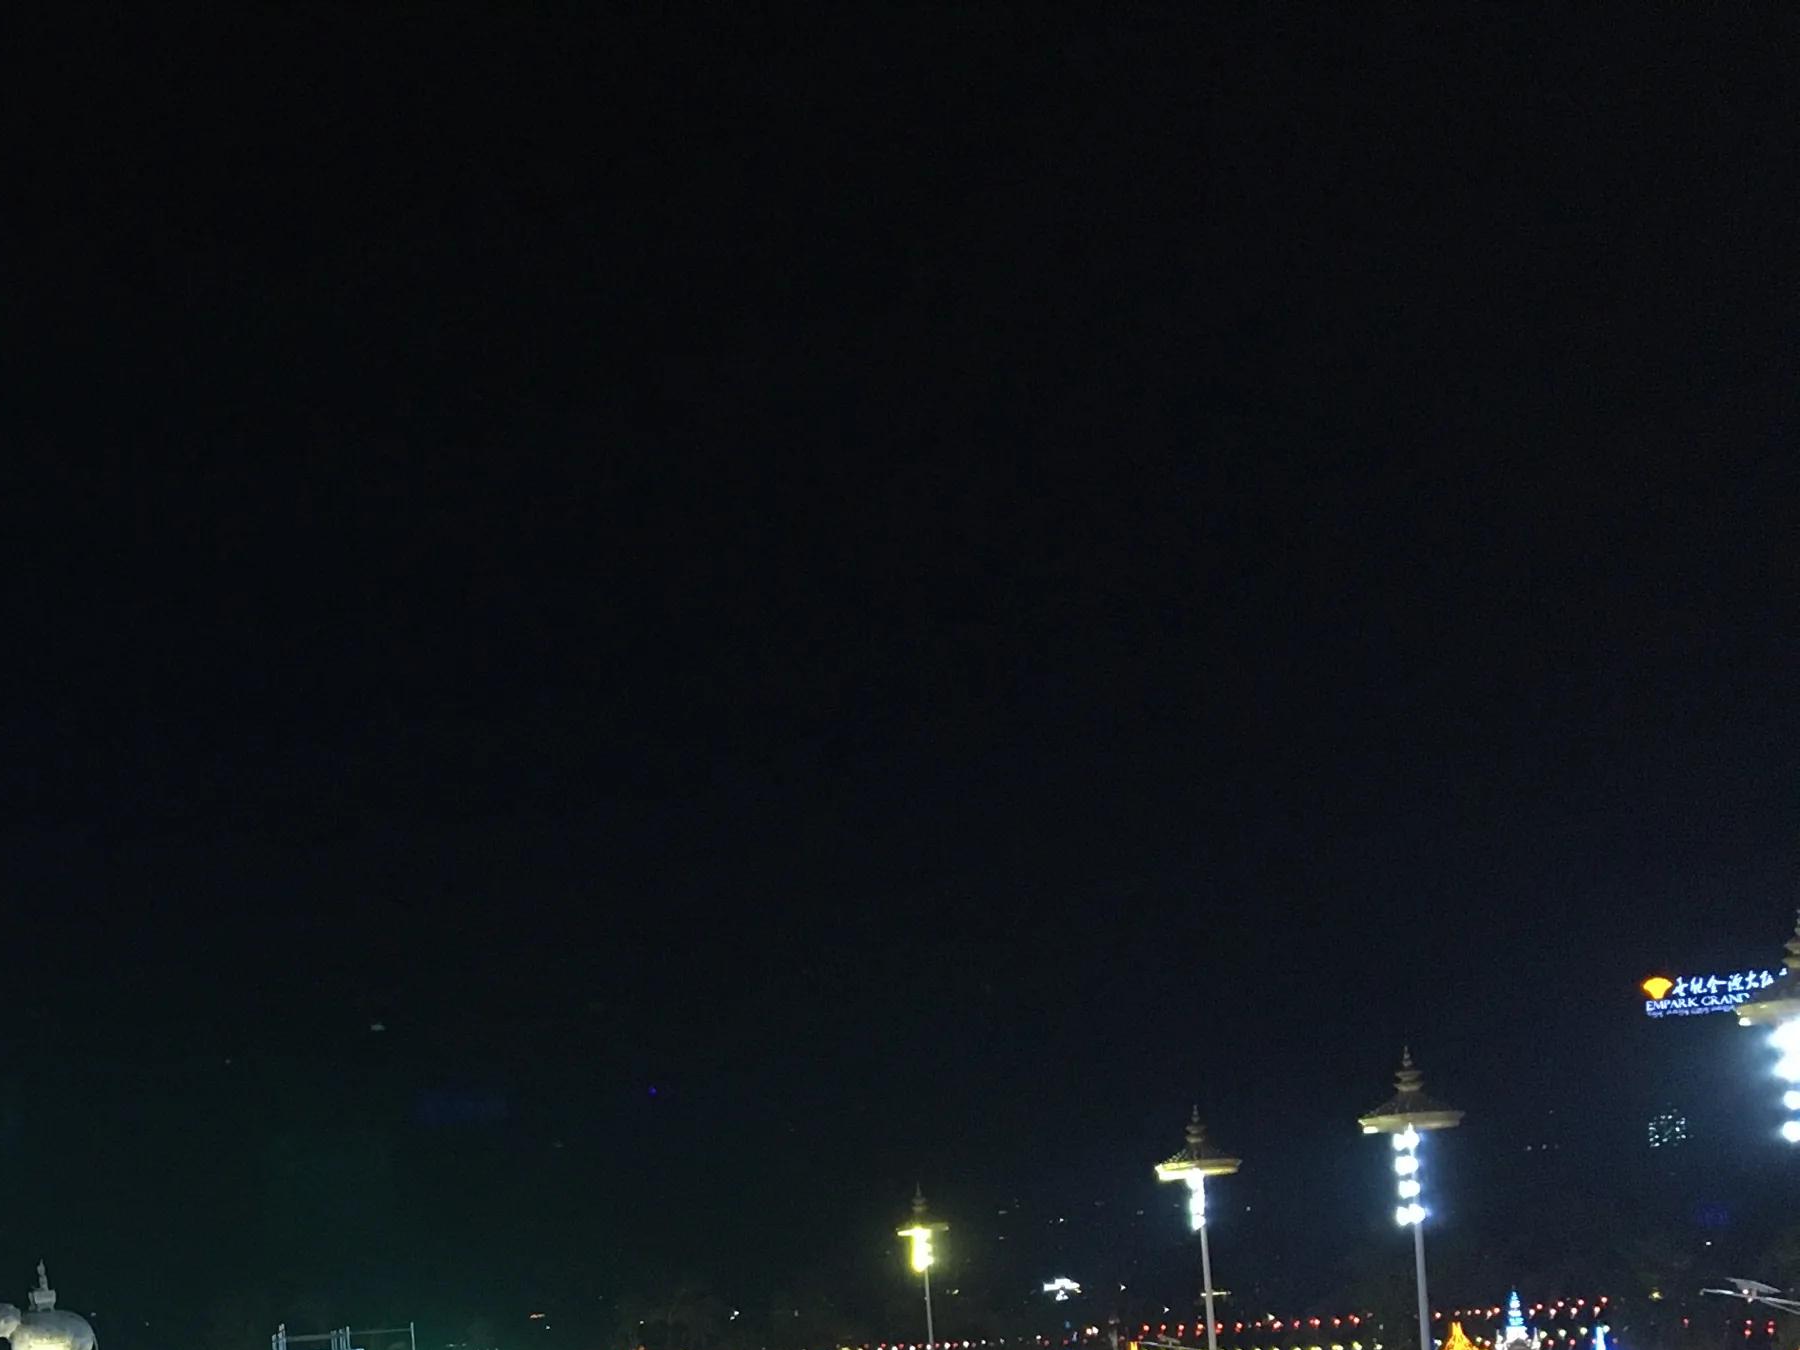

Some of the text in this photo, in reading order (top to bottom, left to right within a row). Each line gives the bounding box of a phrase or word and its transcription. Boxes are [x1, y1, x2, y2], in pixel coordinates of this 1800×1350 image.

[1672, 968, 1788, 997] 世纪金源大饭
[1645, 996, 1699, 1012] EMPARK
